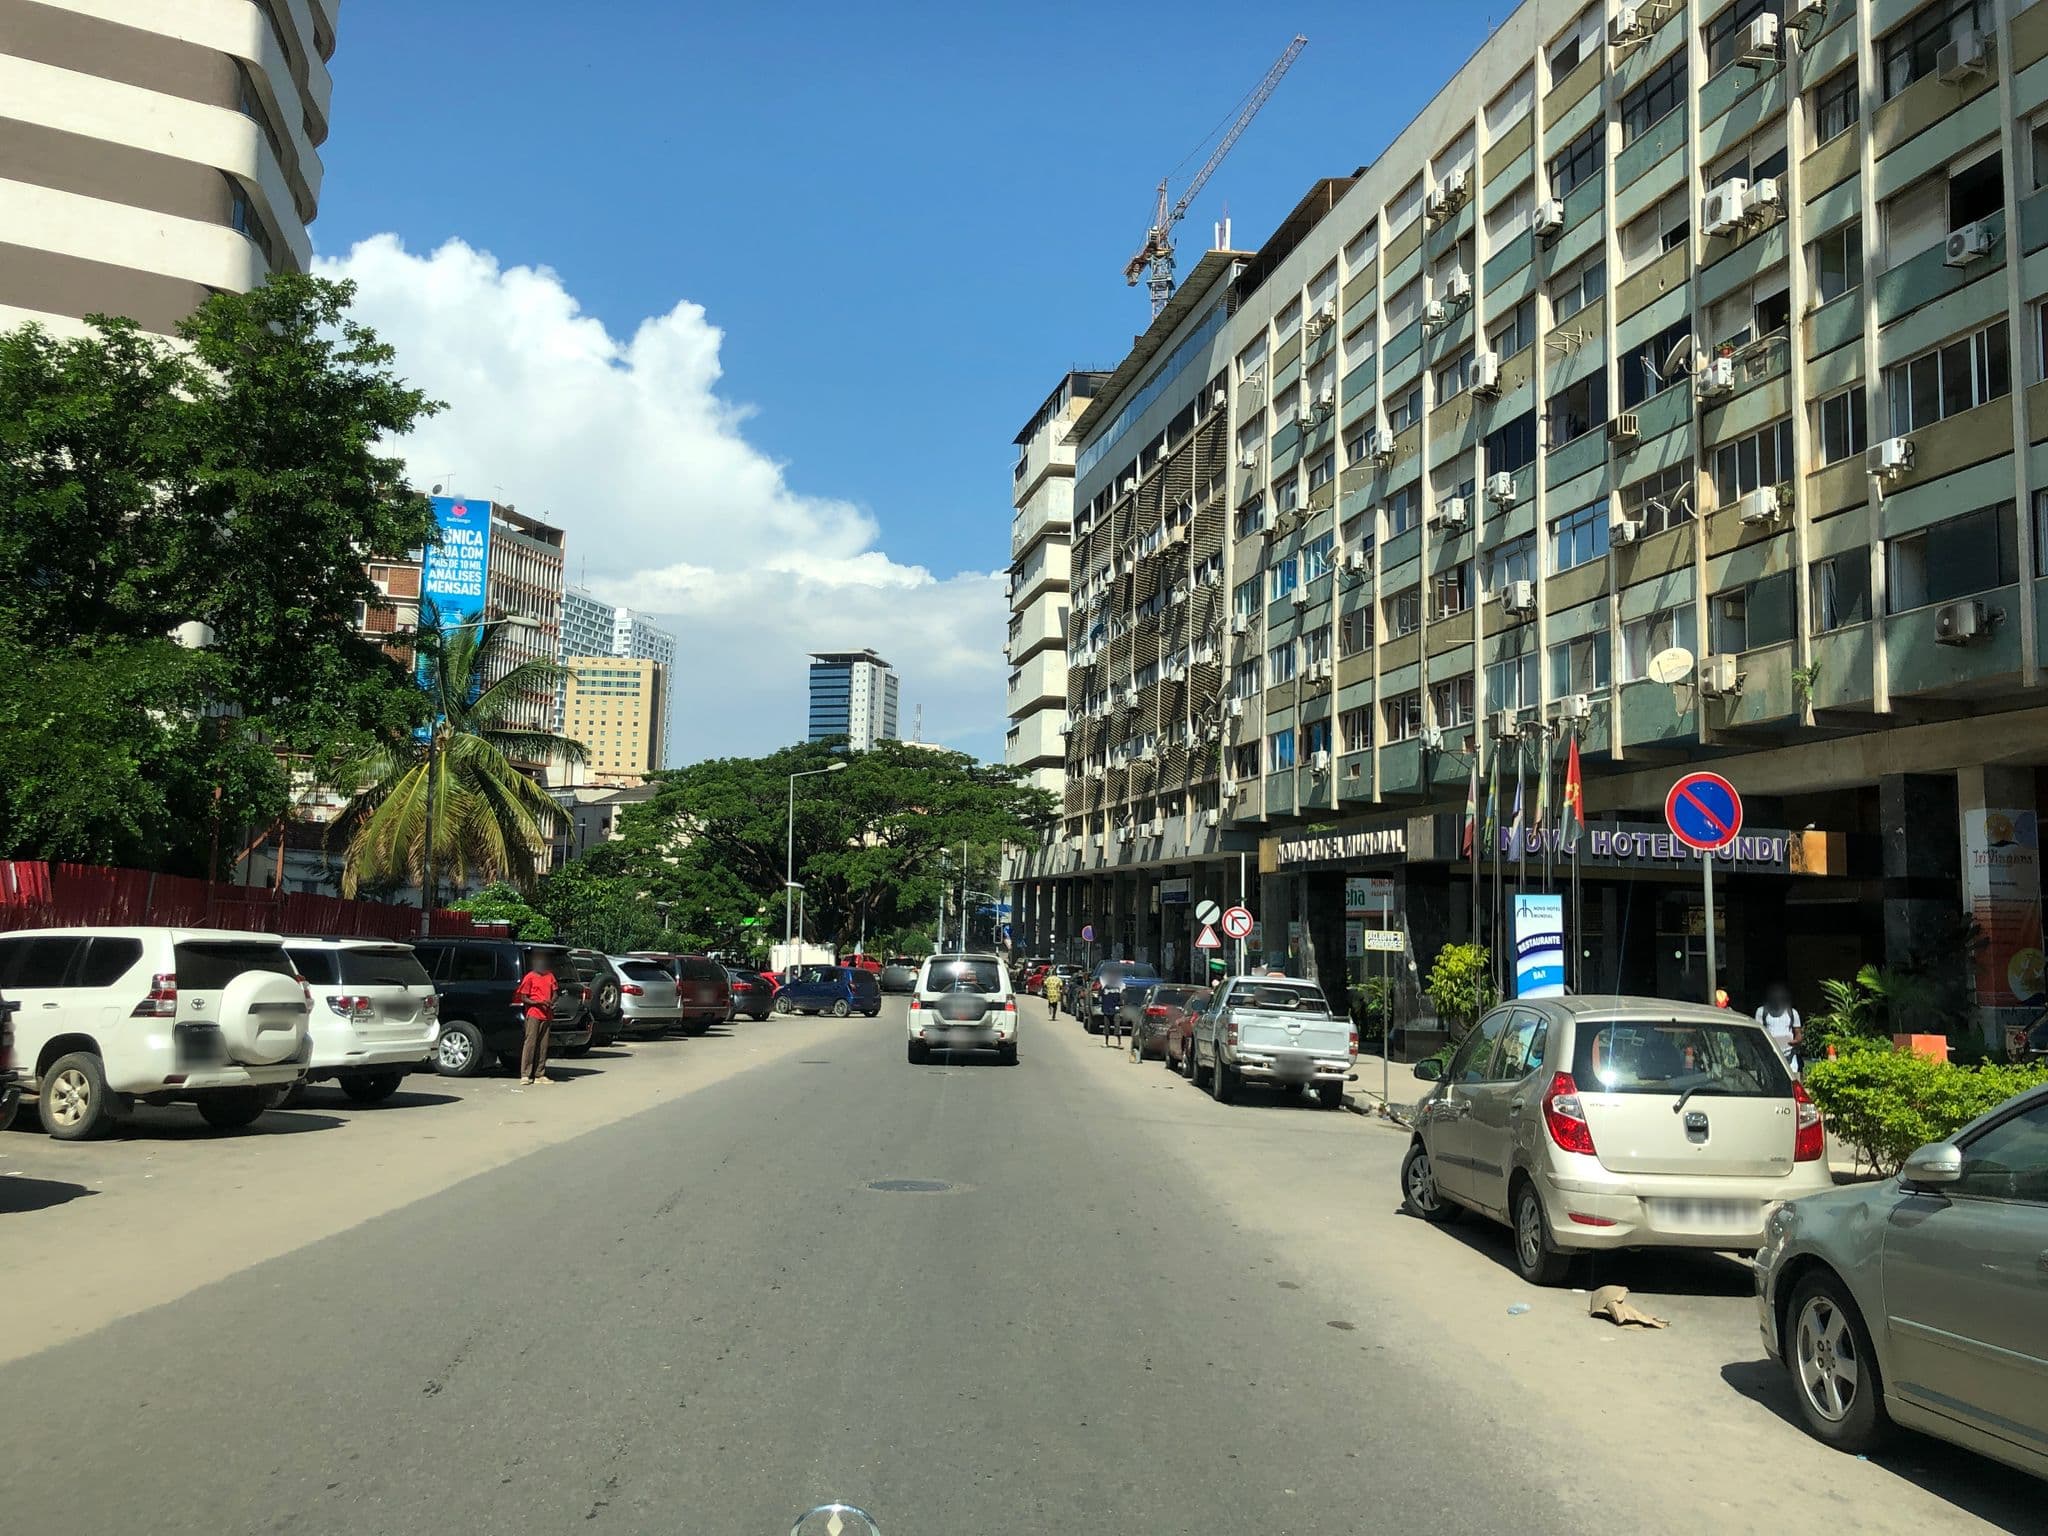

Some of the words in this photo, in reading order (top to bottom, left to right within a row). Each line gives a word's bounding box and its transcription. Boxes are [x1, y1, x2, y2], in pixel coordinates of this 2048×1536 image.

[460, 546, 483, 559] COM
[429, 557, 447, 567] MAIS
[448, 558, 458, 568] DE
[460, 559, 468, 568] 10
[470, 560, 482, 570] MIL
[426, 580, 481, 595] MENSAIS
[1308, 836, 1345, 861] HOTEL
[1346, 829, 1406, 857] MUNDIAL
[1591, 829, 1687, 859] HOTEL
[1517, 935, 1560, 953] RESTAURANTE
[1532, 969, 1546, 980] BAR
